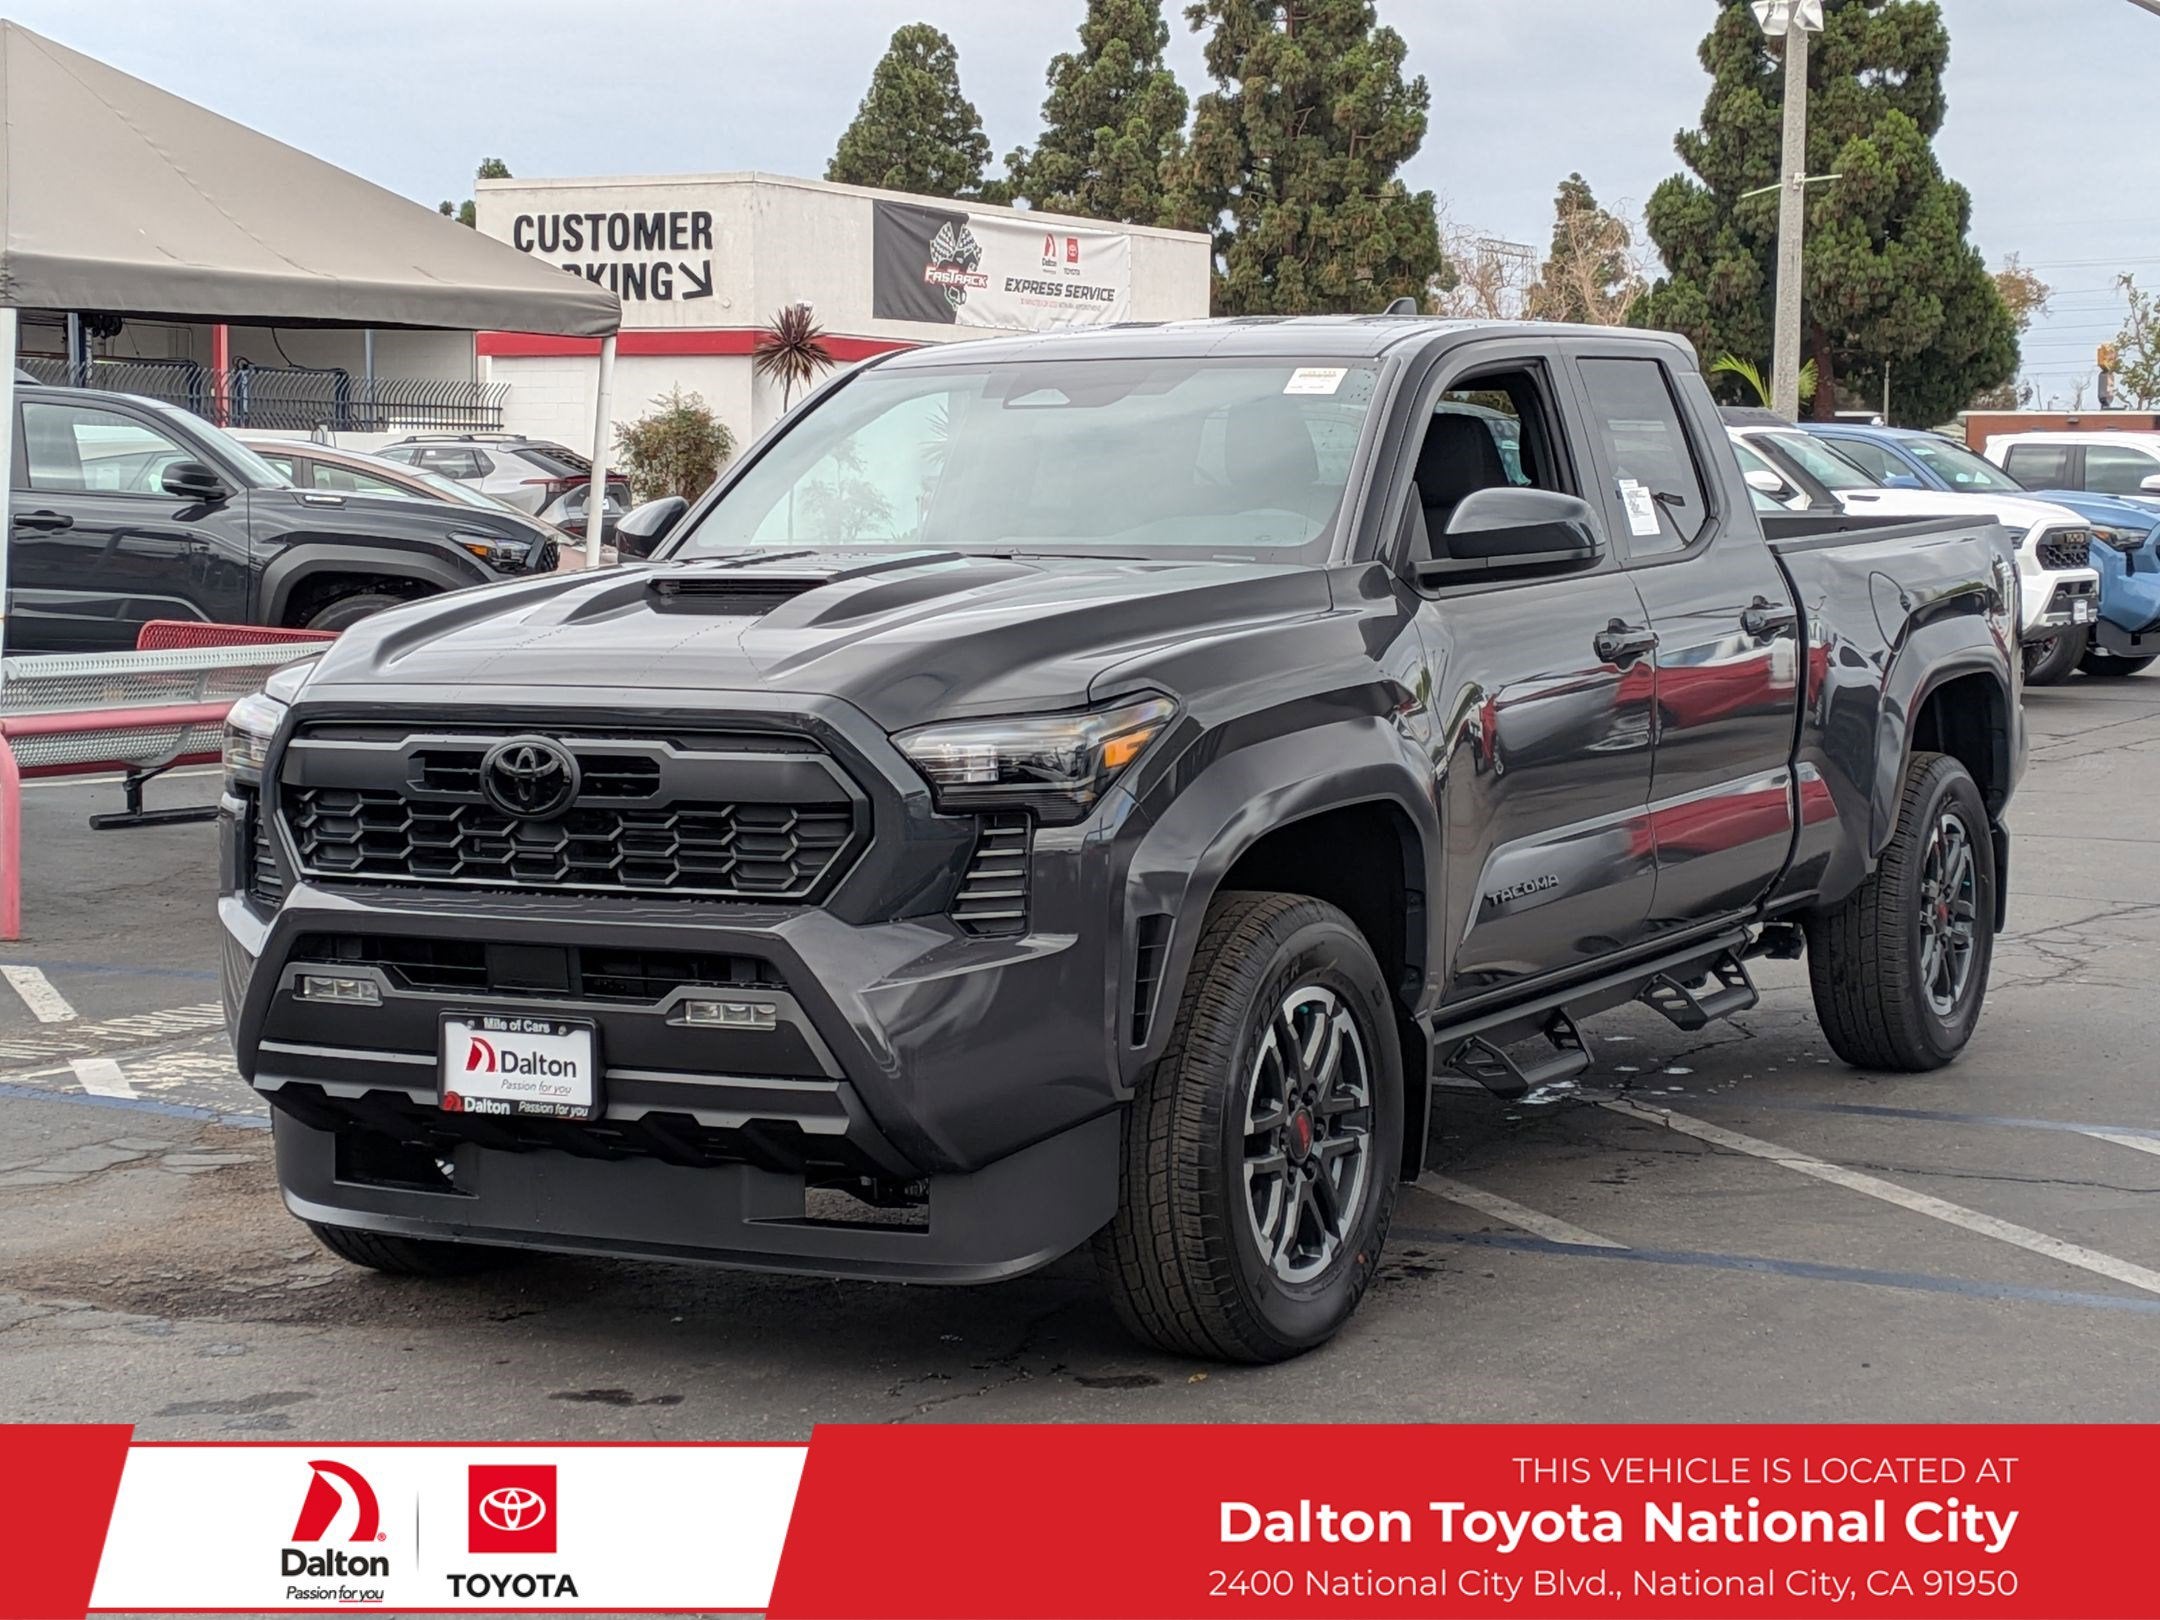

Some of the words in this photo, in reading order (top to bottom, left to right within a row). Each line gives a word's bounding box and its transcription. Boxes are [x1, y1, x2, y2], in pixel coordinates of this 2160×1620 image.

[513, 211, 713, 252] CUSTOMER
[1004, 277, 1063, 297] EXPRESS
[1064, 284, 1115, 302] SERVICE
[1486, 873, 1560, 905] TACOMA
[483, 1017, 508, 1030] Mile
[509, 1019, 521, 1031] of
[523, 1020, 551, 1033] Cars
[501, 1050, 577, 1078] Dalton
[501, 1079, 537, 1092] Passion
[539, 1081, 553, 1093] for
[553, 1084, 572, 1095] you
[464, 1097, 511, 1115] Dalton
[518, 1101, 553, 1115] Passion
[554, 1103, 569, 1116] for
[569, 1106, 589, 1118] you
